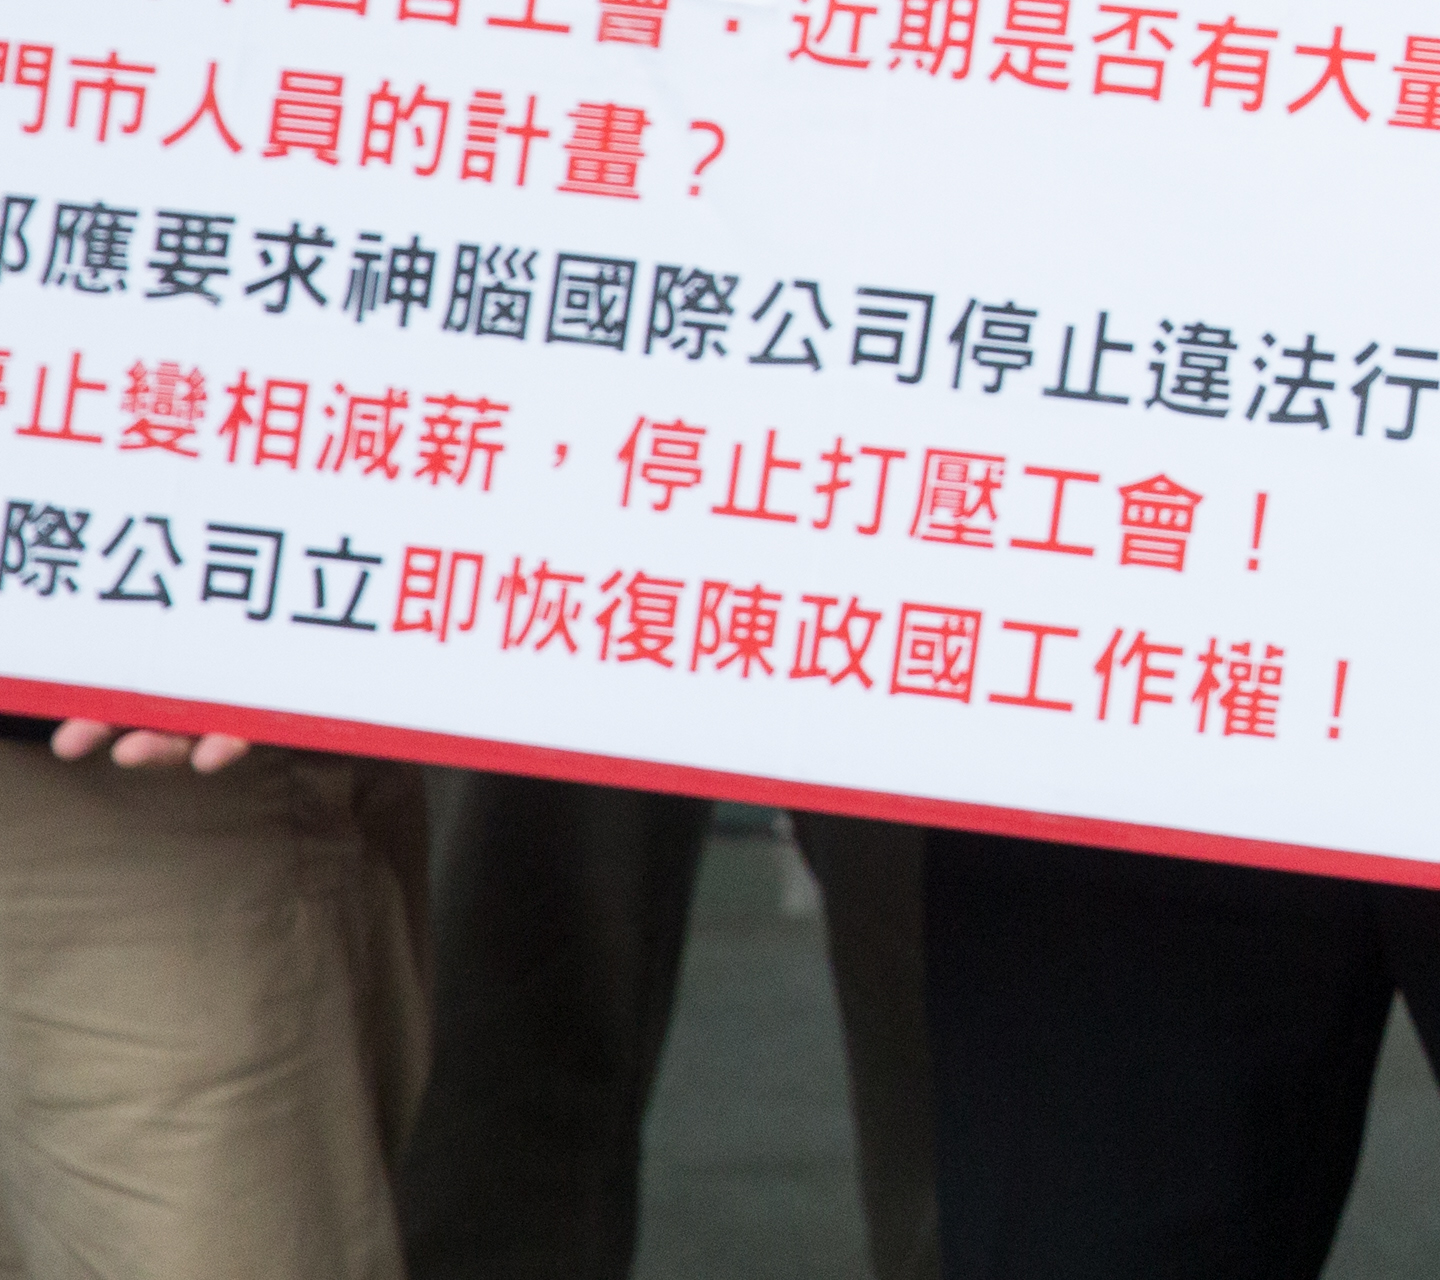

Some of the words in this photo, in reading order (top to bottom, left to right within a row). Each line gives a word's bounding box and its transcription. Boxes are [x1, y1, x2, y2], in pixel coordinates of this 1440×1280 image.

[0, 346, 1269, 574] 止變相減薪，停止打壓工會！
